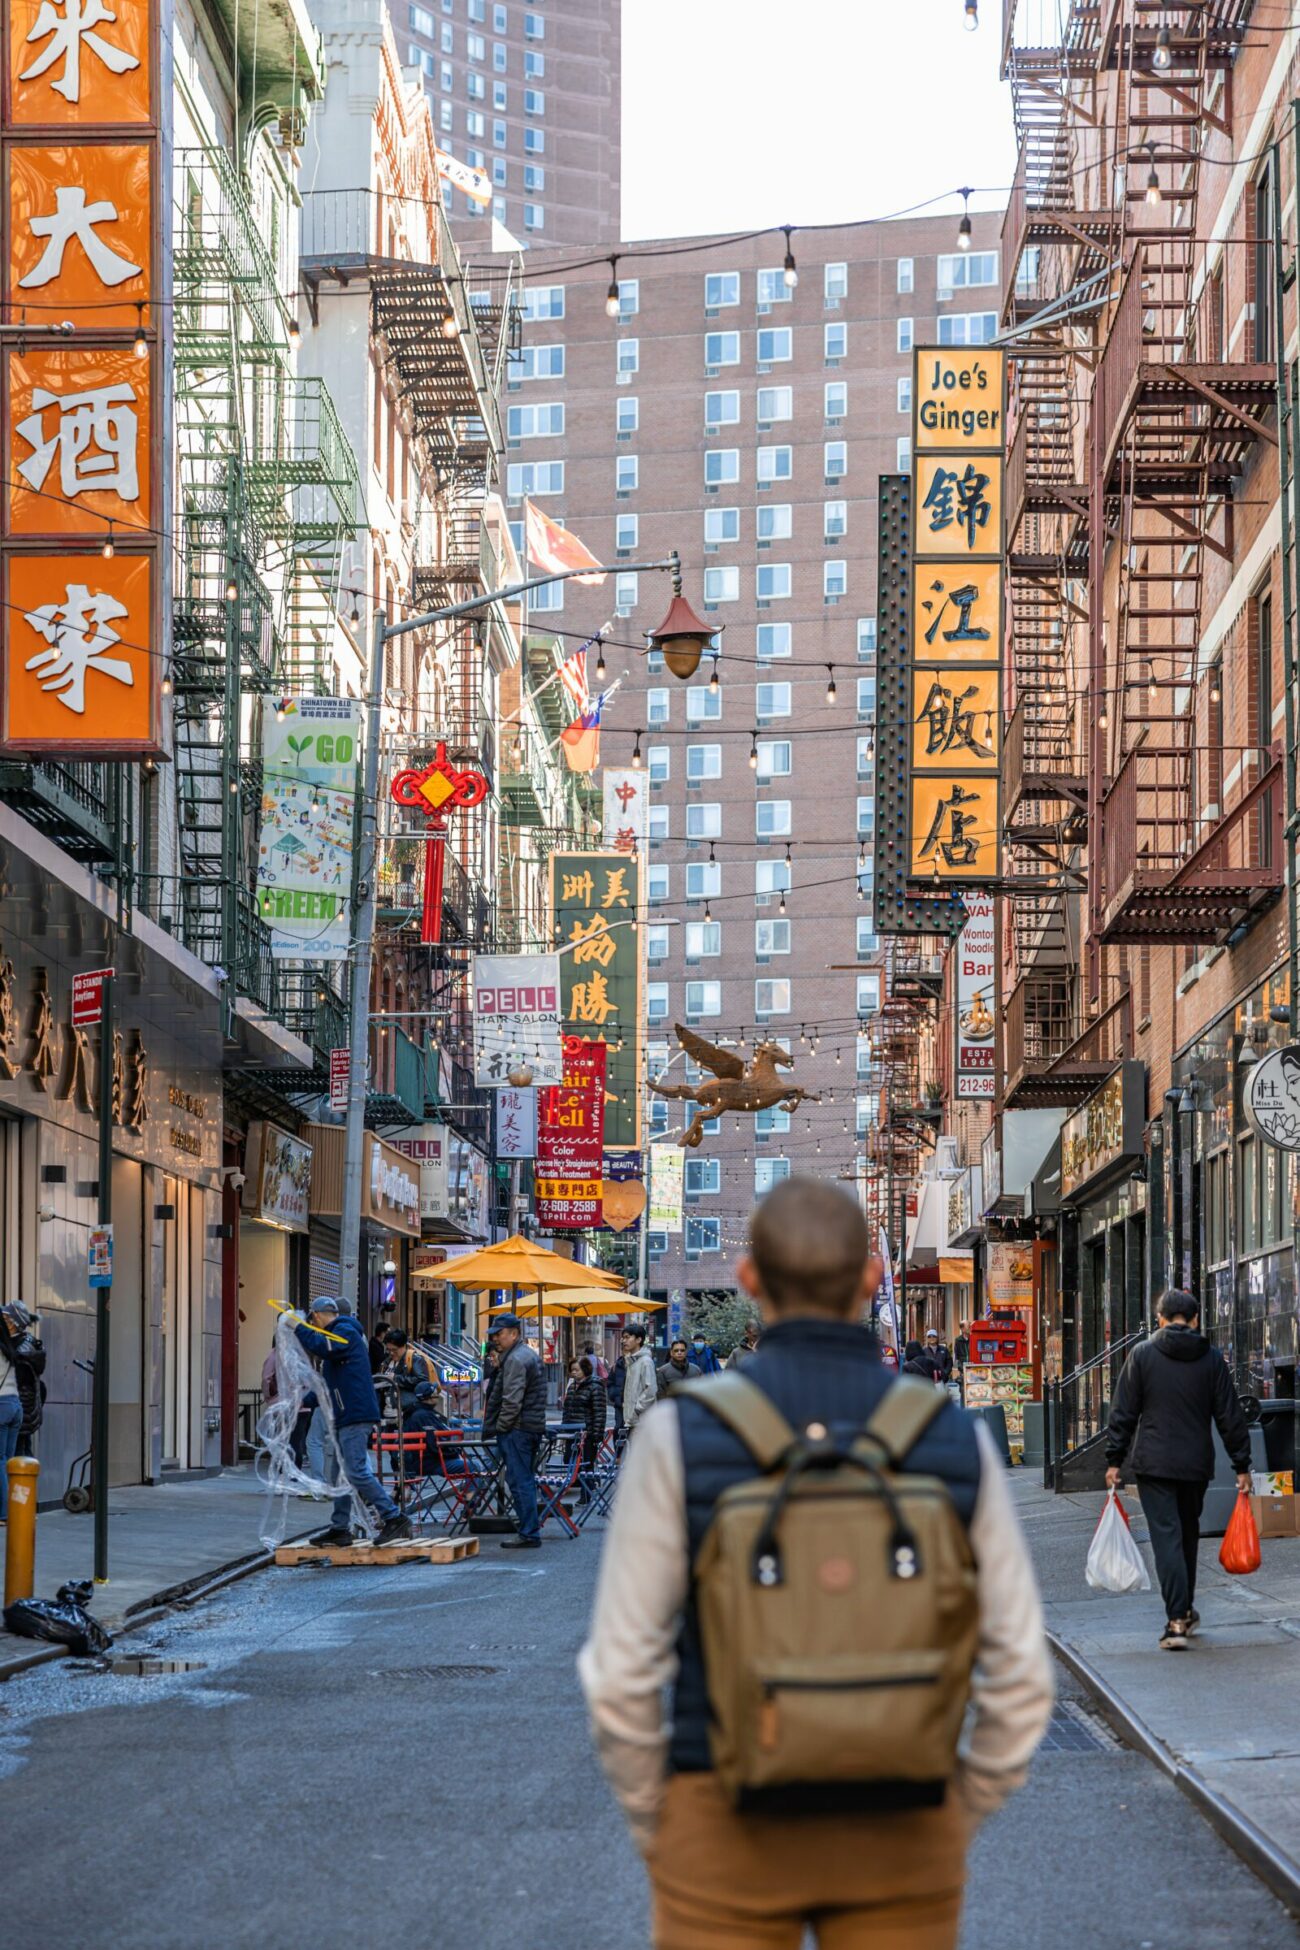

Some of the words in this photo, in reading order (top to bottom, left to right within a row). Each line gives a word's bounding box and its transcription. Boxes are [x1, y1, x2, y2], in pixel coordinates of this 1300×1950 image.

[931, 361, 987, 390] Joe's
[920, 400, 999, 436] Ginger
[917, 464, 996, 867] 錦江飯店
[317, 735, 352, 763] GO
[259, 889, 336, 919] GREEN
[303, 940, 331, 952] 200
[963, 961, 994, 976] Bar
[75, 979, 82, 990] NO
[479, 990, 552, 1011] PELL
[478, 1015, 507, 1024] HAIR
[514, 1013, 557, 1023] SALON
[562, 1071, 590, 1088] air
[1256, 1079, 1280, 1099] 杜
[592, 1076, 600, 1134] 18Pell.com
[552, 1146, 575, 1155] Color
[559, 1170, 591, 1178] Treatment
